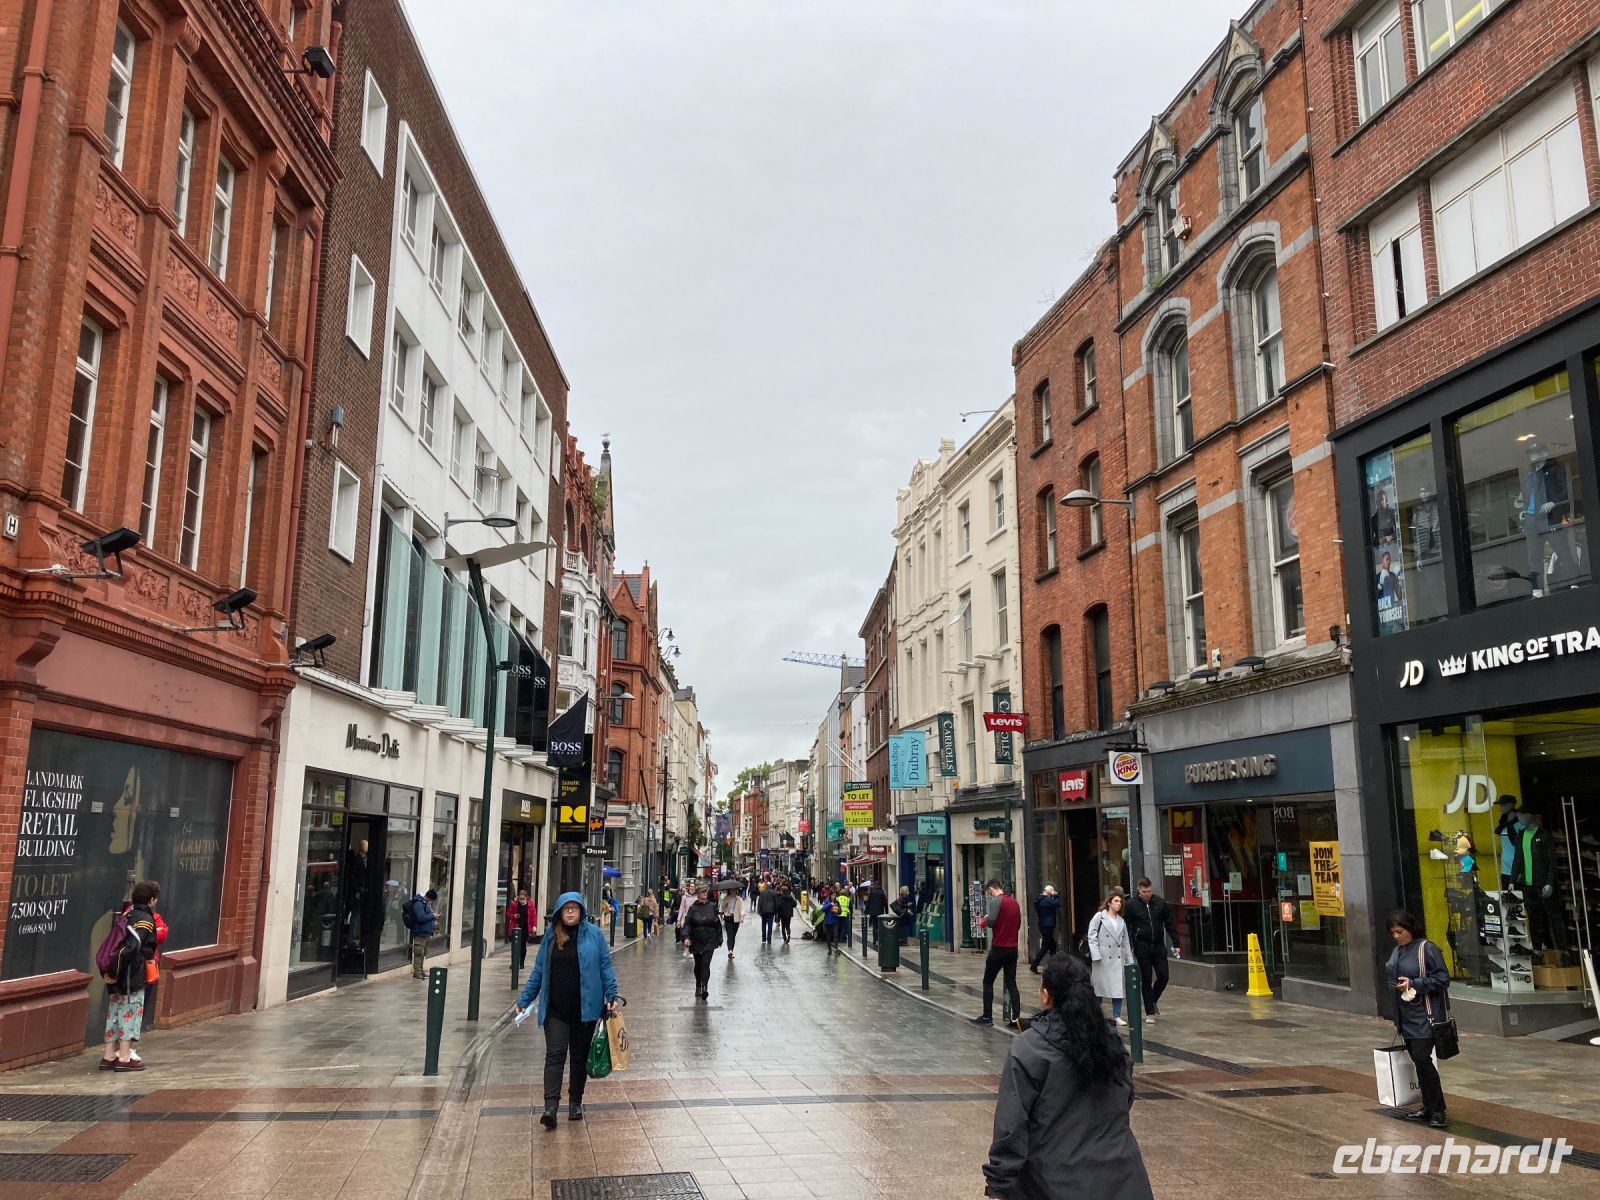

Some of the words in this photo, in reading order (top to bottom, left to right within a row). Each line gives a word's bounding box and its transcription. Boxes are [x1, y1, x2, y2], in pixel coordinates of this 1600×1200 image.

[1378, 605, 1403, 624] YOURSELF
[1472, 642, 1524, 671] KING
[1526, 637, 1549, 654] OF
[1400, 660, 1424, 688] JD
[550, 742, 581, 752] BOSS
[891, 742, 900, 783] Bookshop
[908, 737, 922, 781] Dubray
[1116, 758, 1137, 769] BURGER
[1117, 763, 1138, 776] KING
[1184, 759, 1235, 784] BURGER
[1236, 753, 1273, 777] KING
[26, 770, 84, 789] LANDMARK
[23, 789, 82, 810] FLAGSHIP
[1445, 774, 1498, 814] JD
[20, 812, 79, 836] RETAIL
[17, 839, 76, 857] BUILDING
[1313, 847, 1334, 859] JOIN
[1314, 859, 1331, 872] THE
[14, 874, 38, 897] TO
[41, 873, 72, 897] LET
[1315, 871, 1340, 884] TEAM
[11, 902, 37, 920] 7,500
[37, 900, 52, 920] SQ
[53, 899, 68, 915] FT
